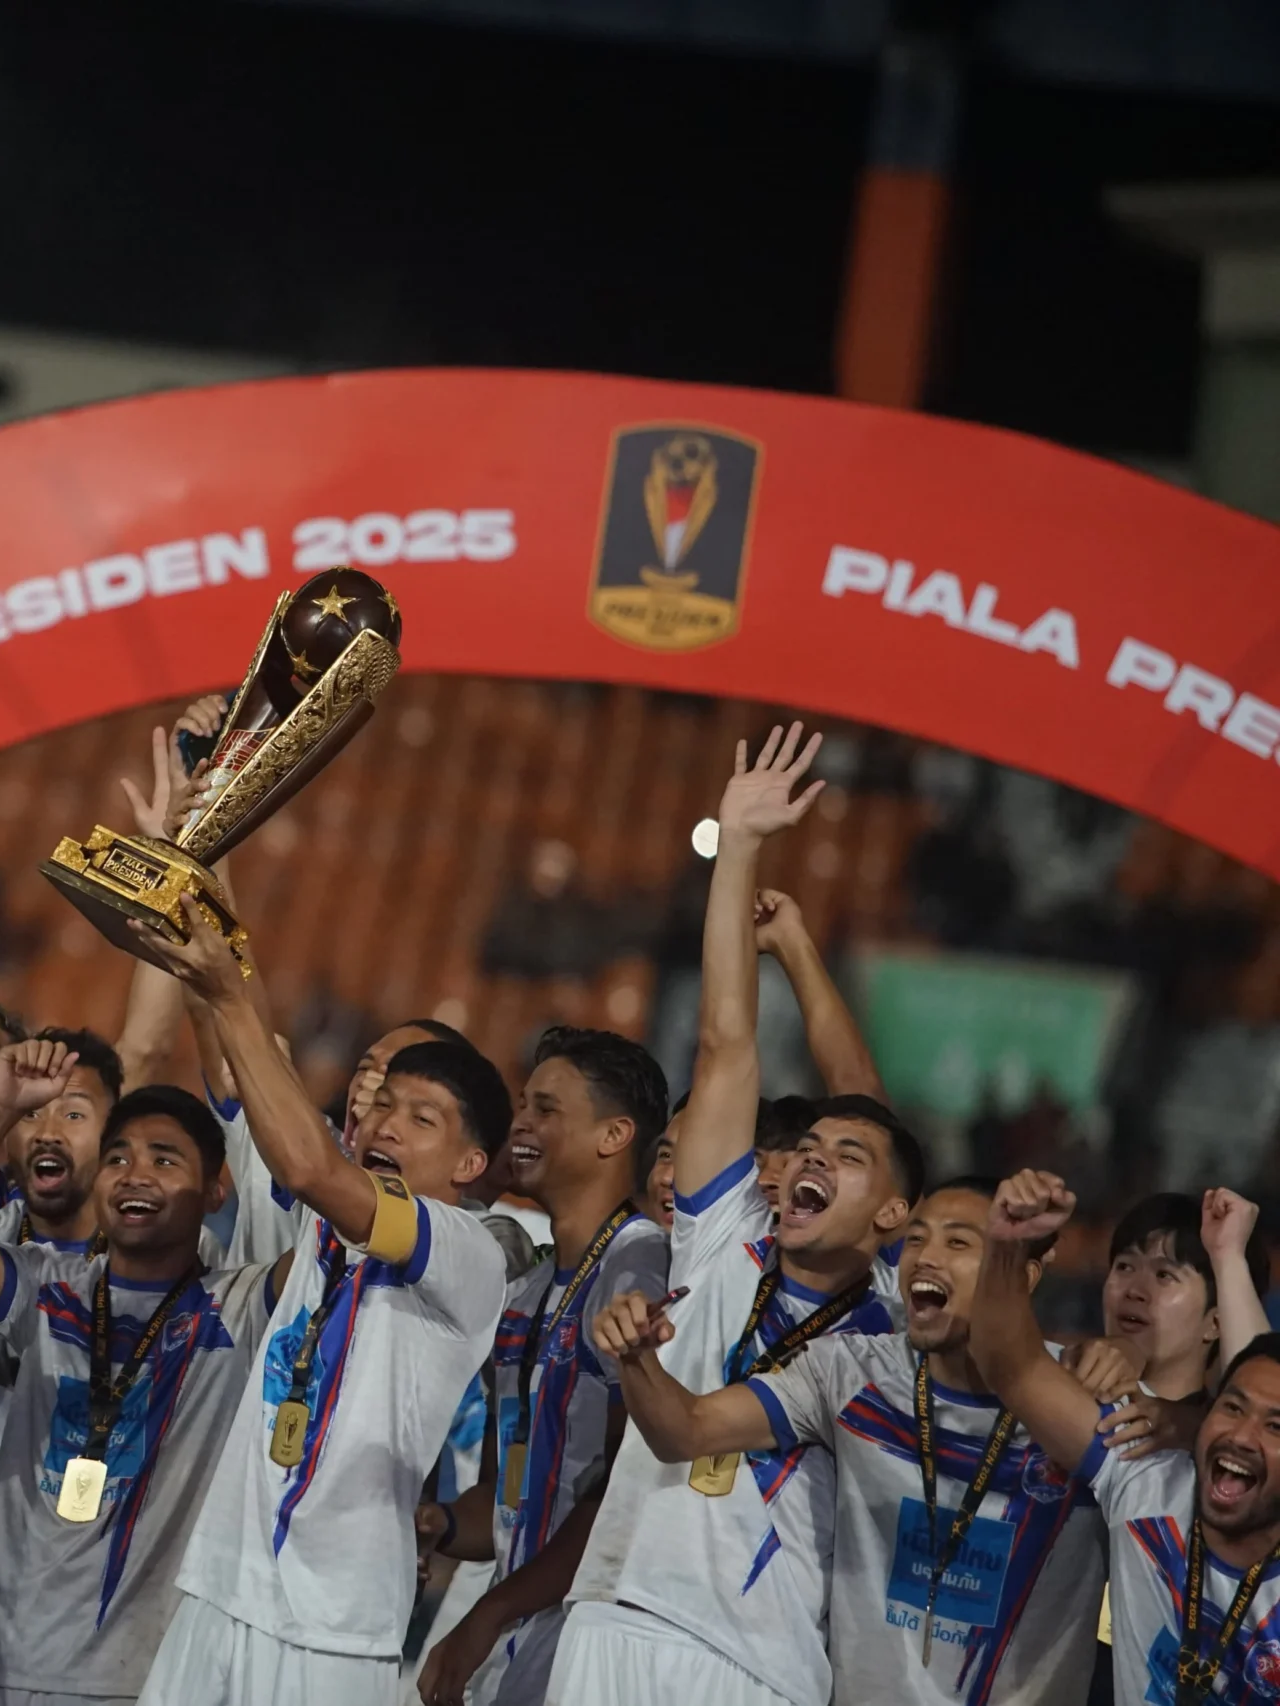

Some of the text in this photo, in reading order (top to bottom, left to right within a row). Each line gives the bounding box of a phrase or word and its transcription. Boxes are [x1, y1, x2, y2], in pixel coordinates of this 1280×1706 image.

[292, 509, 517, 571] 2025
[822, 545, 1280, 768] PIALA PRE
[106, 860, 154, 890] PRESIDEN
[121, 855, 147, 875] PIALA
[590, 1227, 614, 1257] PIALA
[921, 1420, 932, 1453] PIALA
[973, 1410, 1014, 1493] RESIDEN 2025
[1187, 1601, 1198, 1631] 2025
[1231, 1586, 1252, 1620] PIALA
